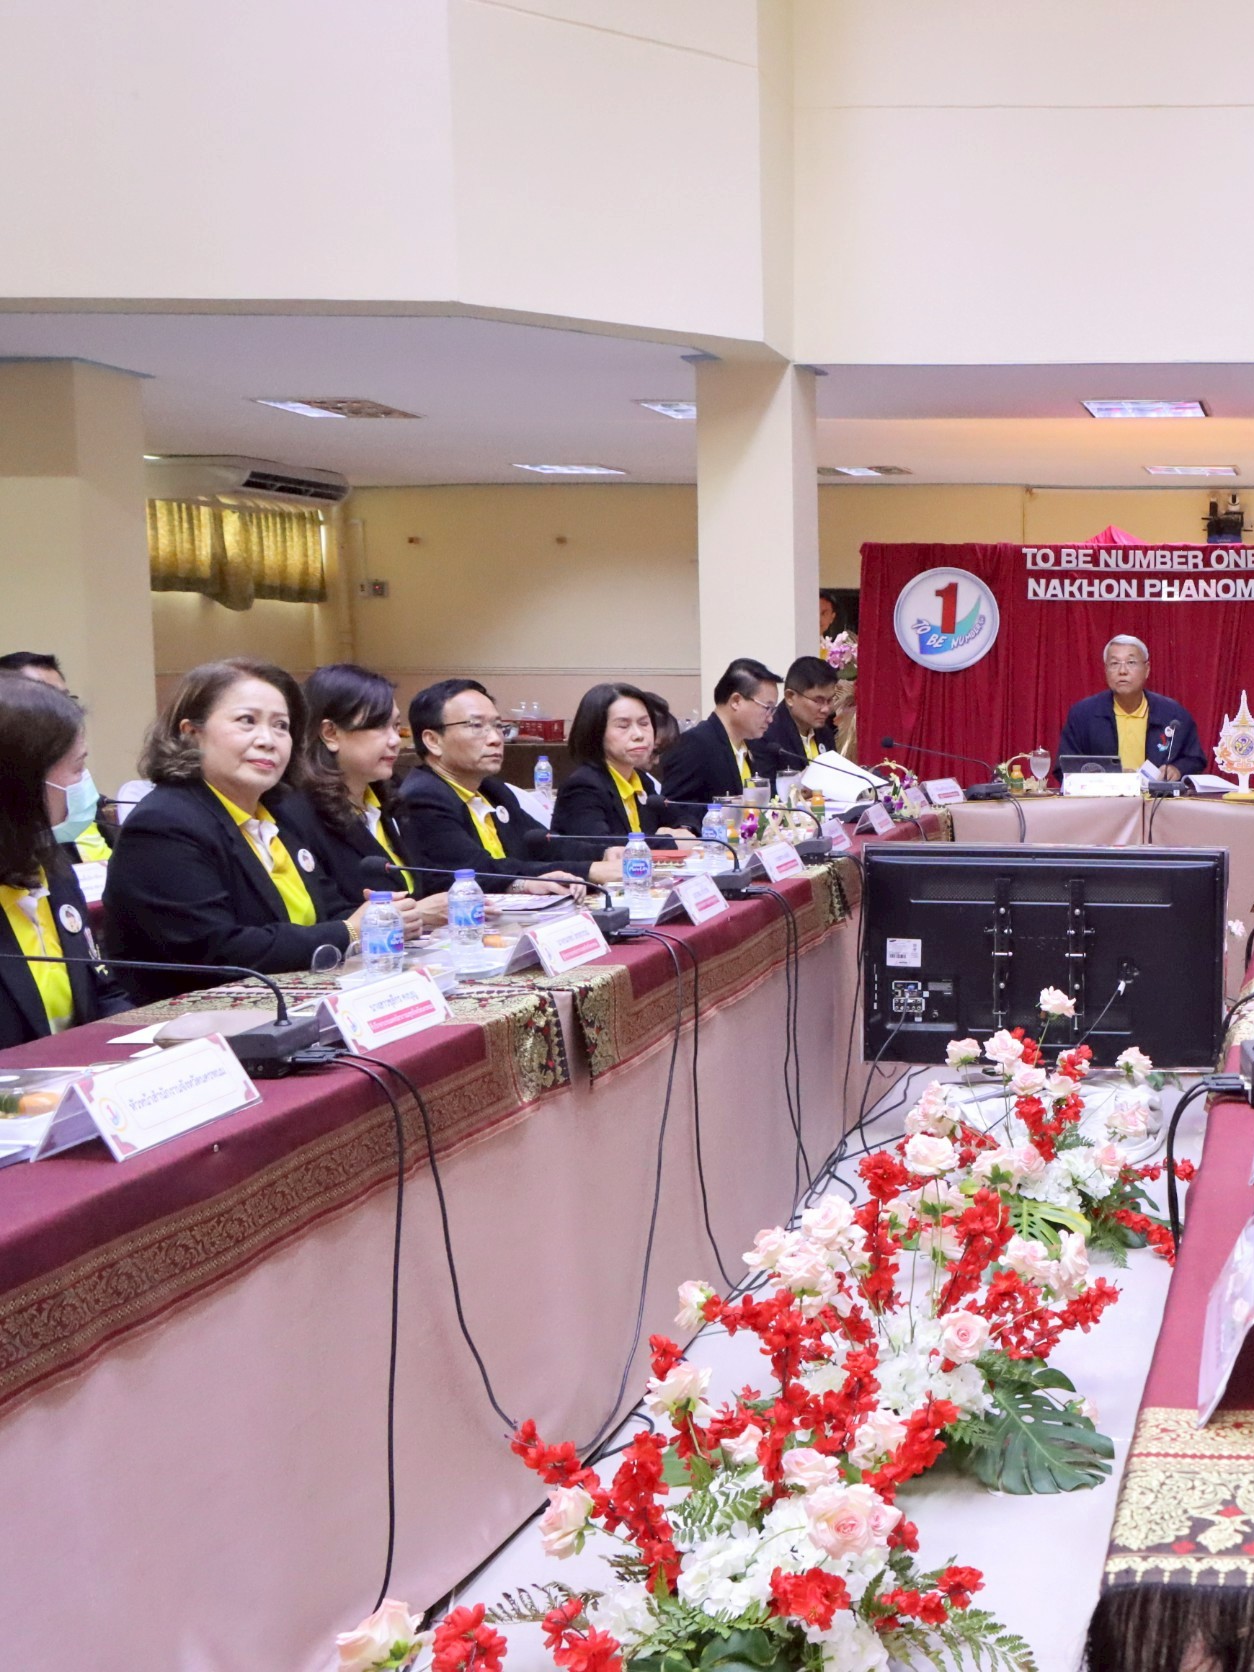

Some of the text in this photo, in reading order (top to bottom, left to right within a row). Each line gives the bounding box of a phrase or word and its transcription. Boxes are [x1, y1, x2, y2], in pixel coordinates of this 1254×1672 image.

[1022, 547, 1054, 568] TO
[1061, 548, 1093, 568] BE
[1100, 548, 1203, 570] NUMBER
[1028, 578, 1137, 599] NAKHON
[935, 582, 958, 634] 1
[926, 633, 947, 648] BE
